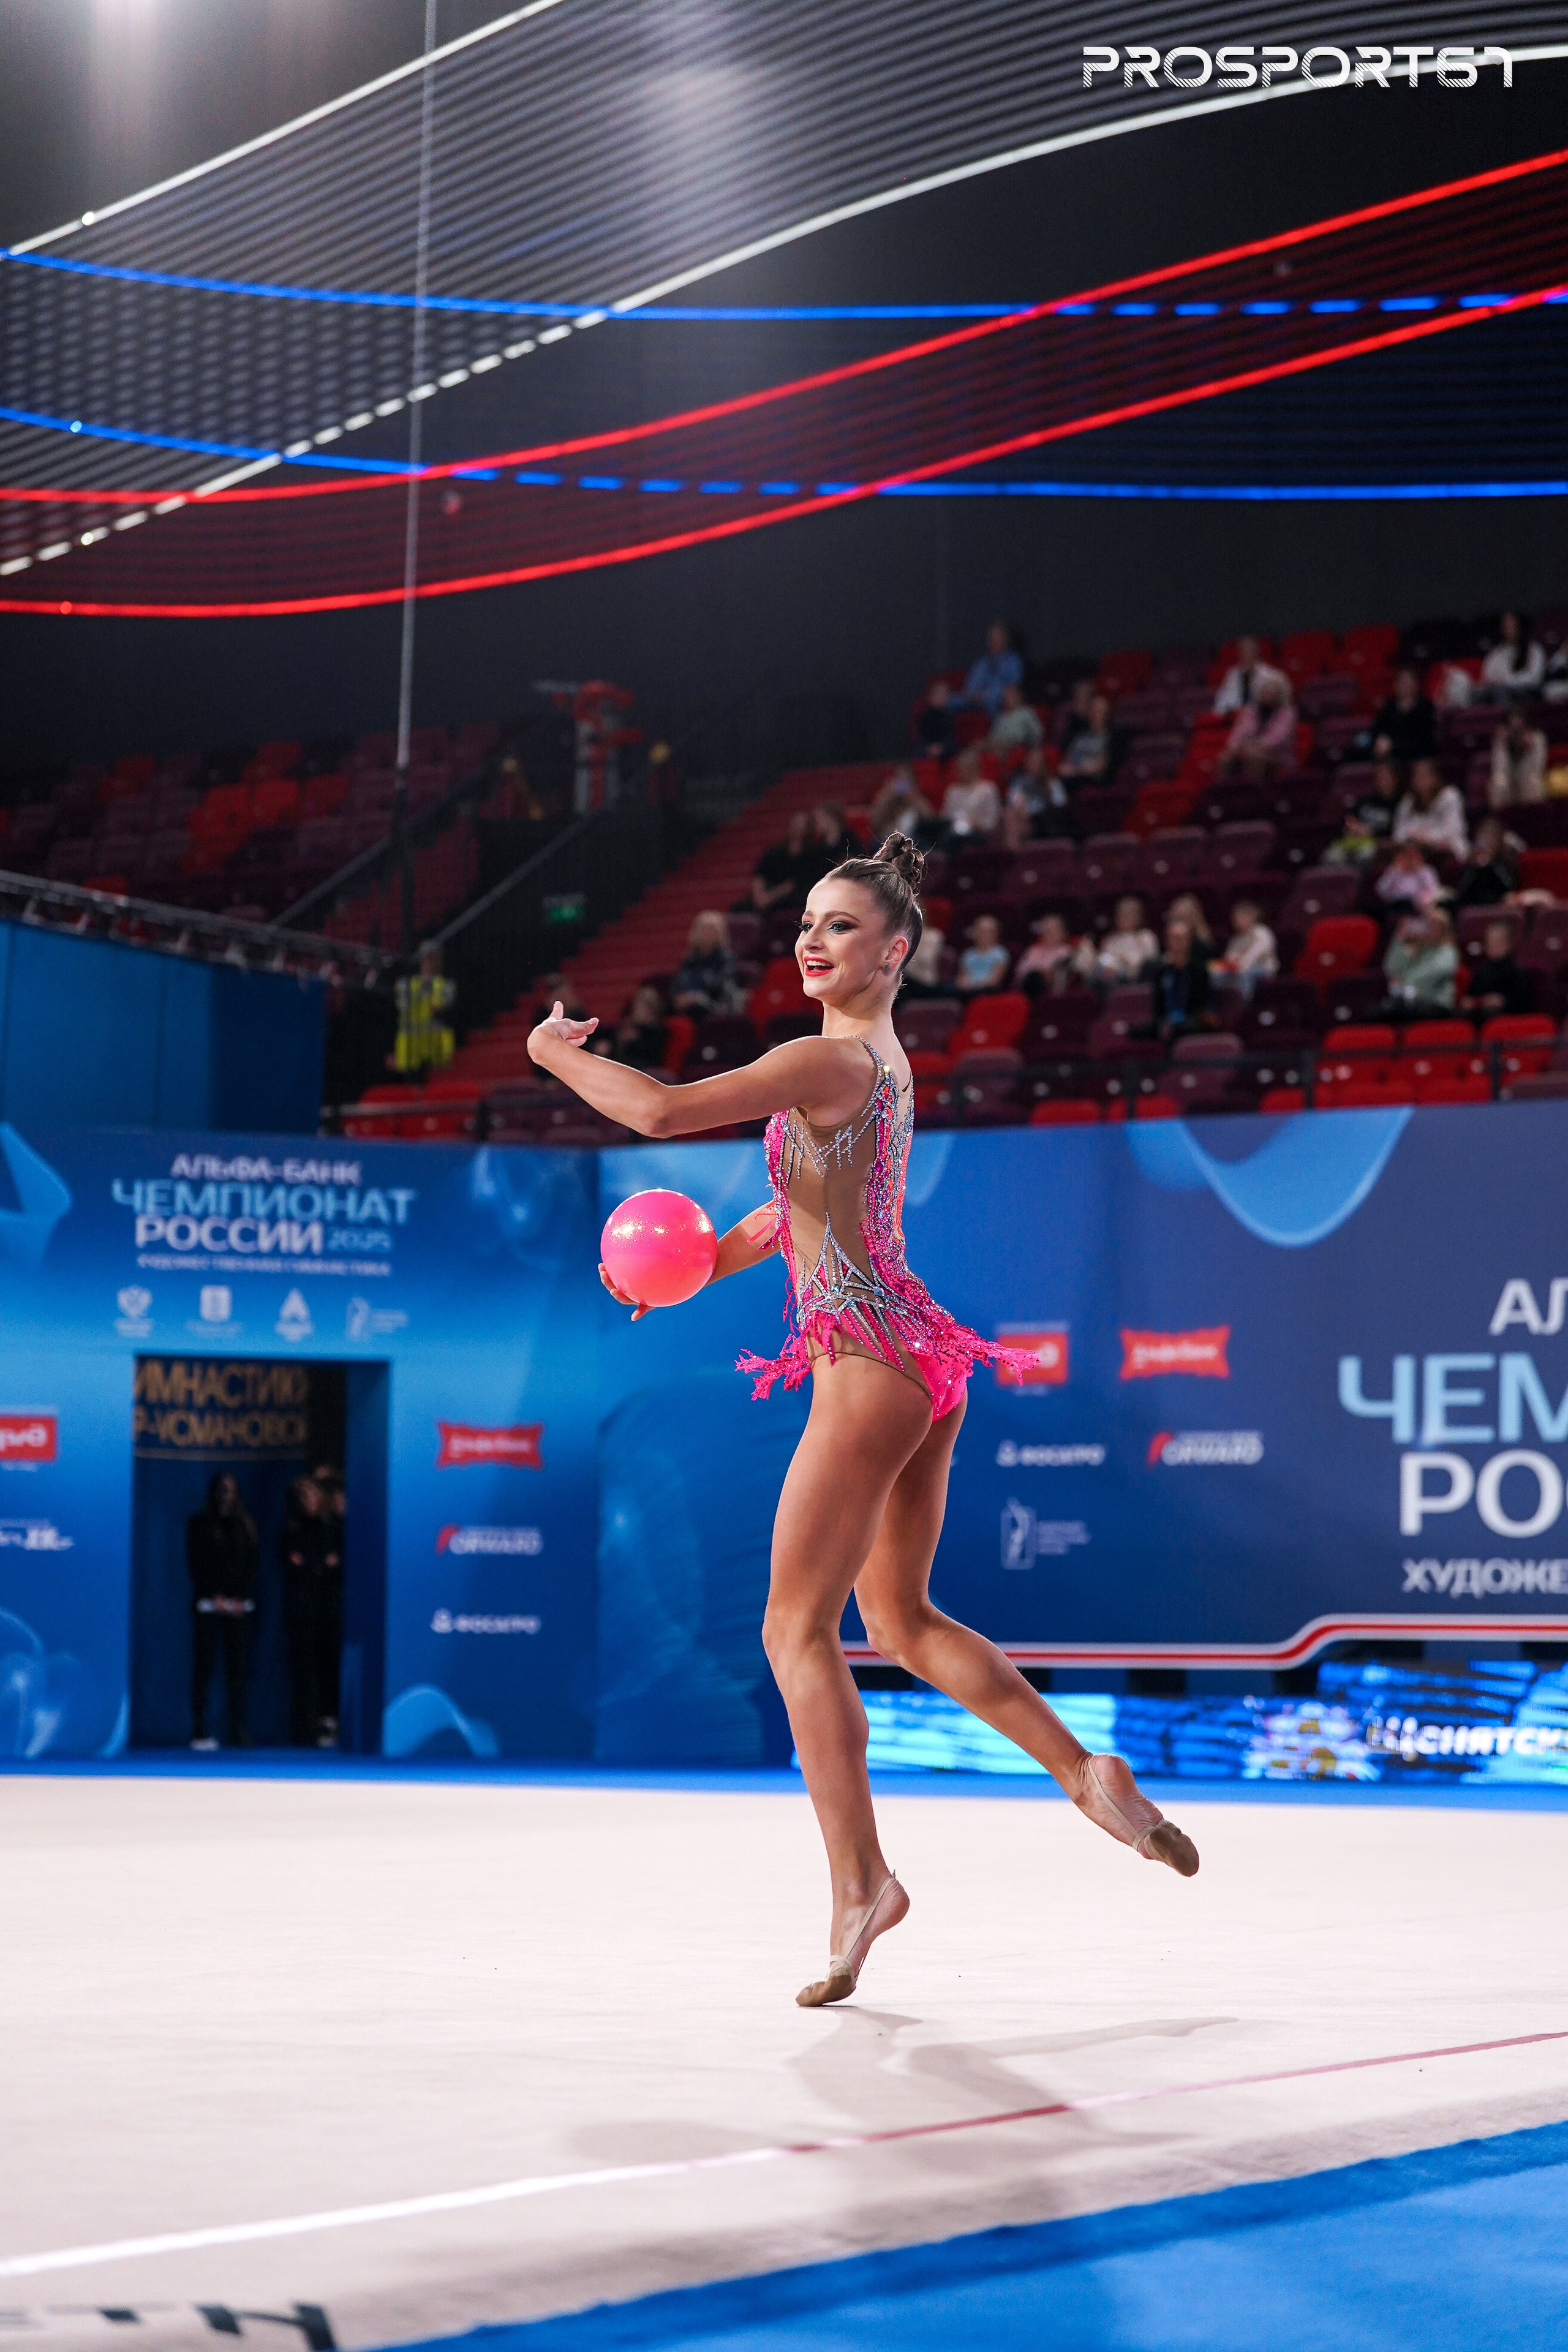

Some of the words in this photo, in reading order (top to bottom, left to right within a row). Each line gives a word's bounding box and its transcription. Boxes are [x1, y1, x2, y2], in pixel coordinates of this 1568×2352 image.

[111, 1178, 418, 1225] ЧЕМПИОНАТ
[135, 1214, 323, 1256] РОССИИ
[1338, 1352, 1568, 1444] ЧЕМ
[1400, 1447, 1568, 1538] РО
